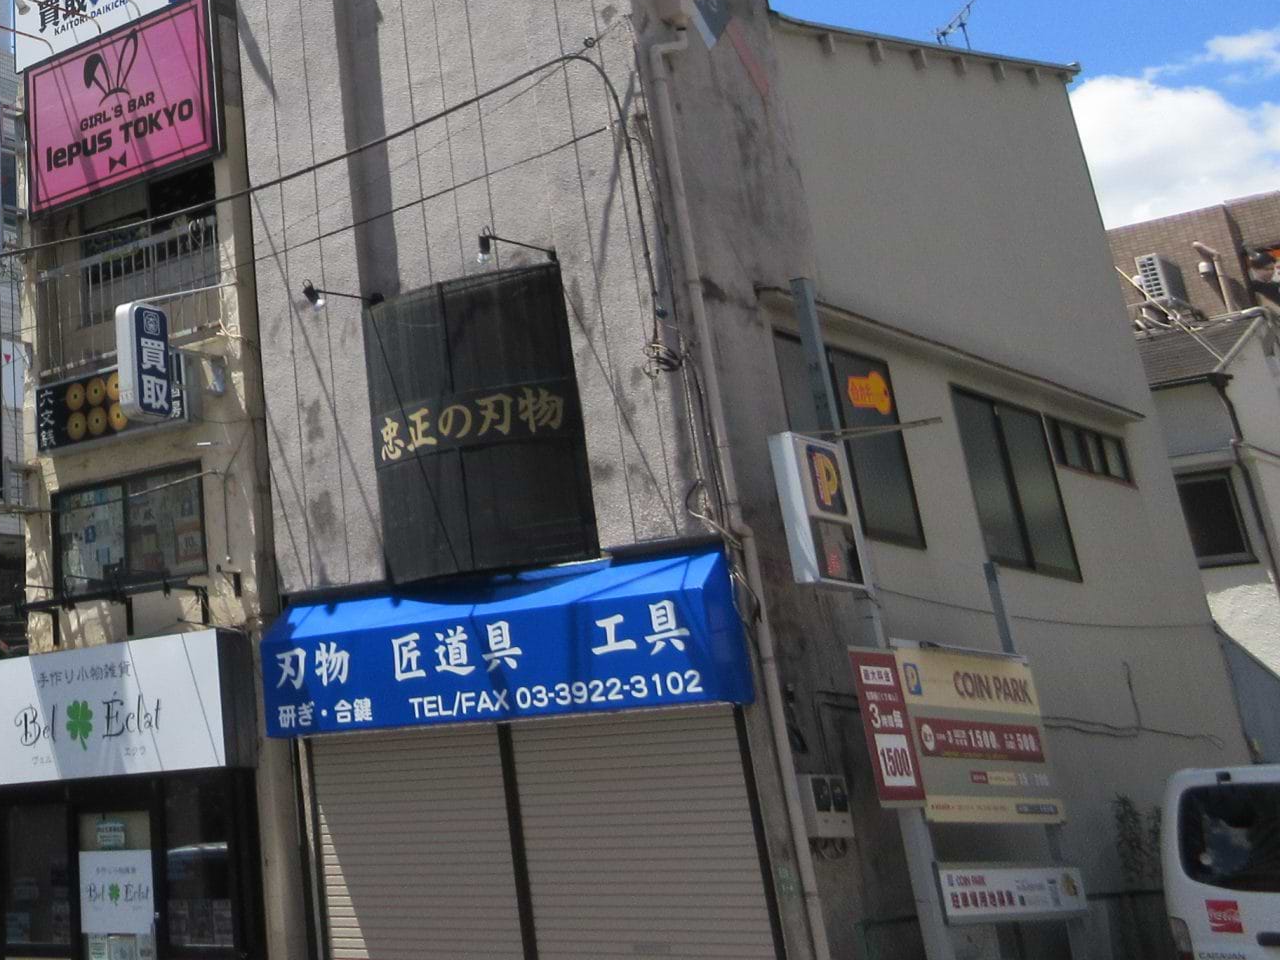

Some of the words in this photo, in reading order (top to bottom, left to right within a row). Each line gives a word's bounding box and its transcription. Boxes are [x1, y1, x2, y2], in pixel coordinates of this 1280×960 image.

[80, 104, 123, 132] GIRL'S
[127, 91, 155, 113] BAR
[119, 98, 194, 144] TOKYO
[141, 338, 169, 411] 買取
[276, 641, 350, 690] 刃物
[391, 620, 523, 682] 匠道具
[592, 599, 690, 657] 工具
[278, 696, 373, 729] 研ぎ・合鍵
[408, 689, 510, 719] TEL/FAX
[515, 670, 704, 710] 03-3922-3102
[953, 670, 993, 699] COIN
[992, 674, 1034, 705] PARK
[15, 703, 58, 747] Bel
